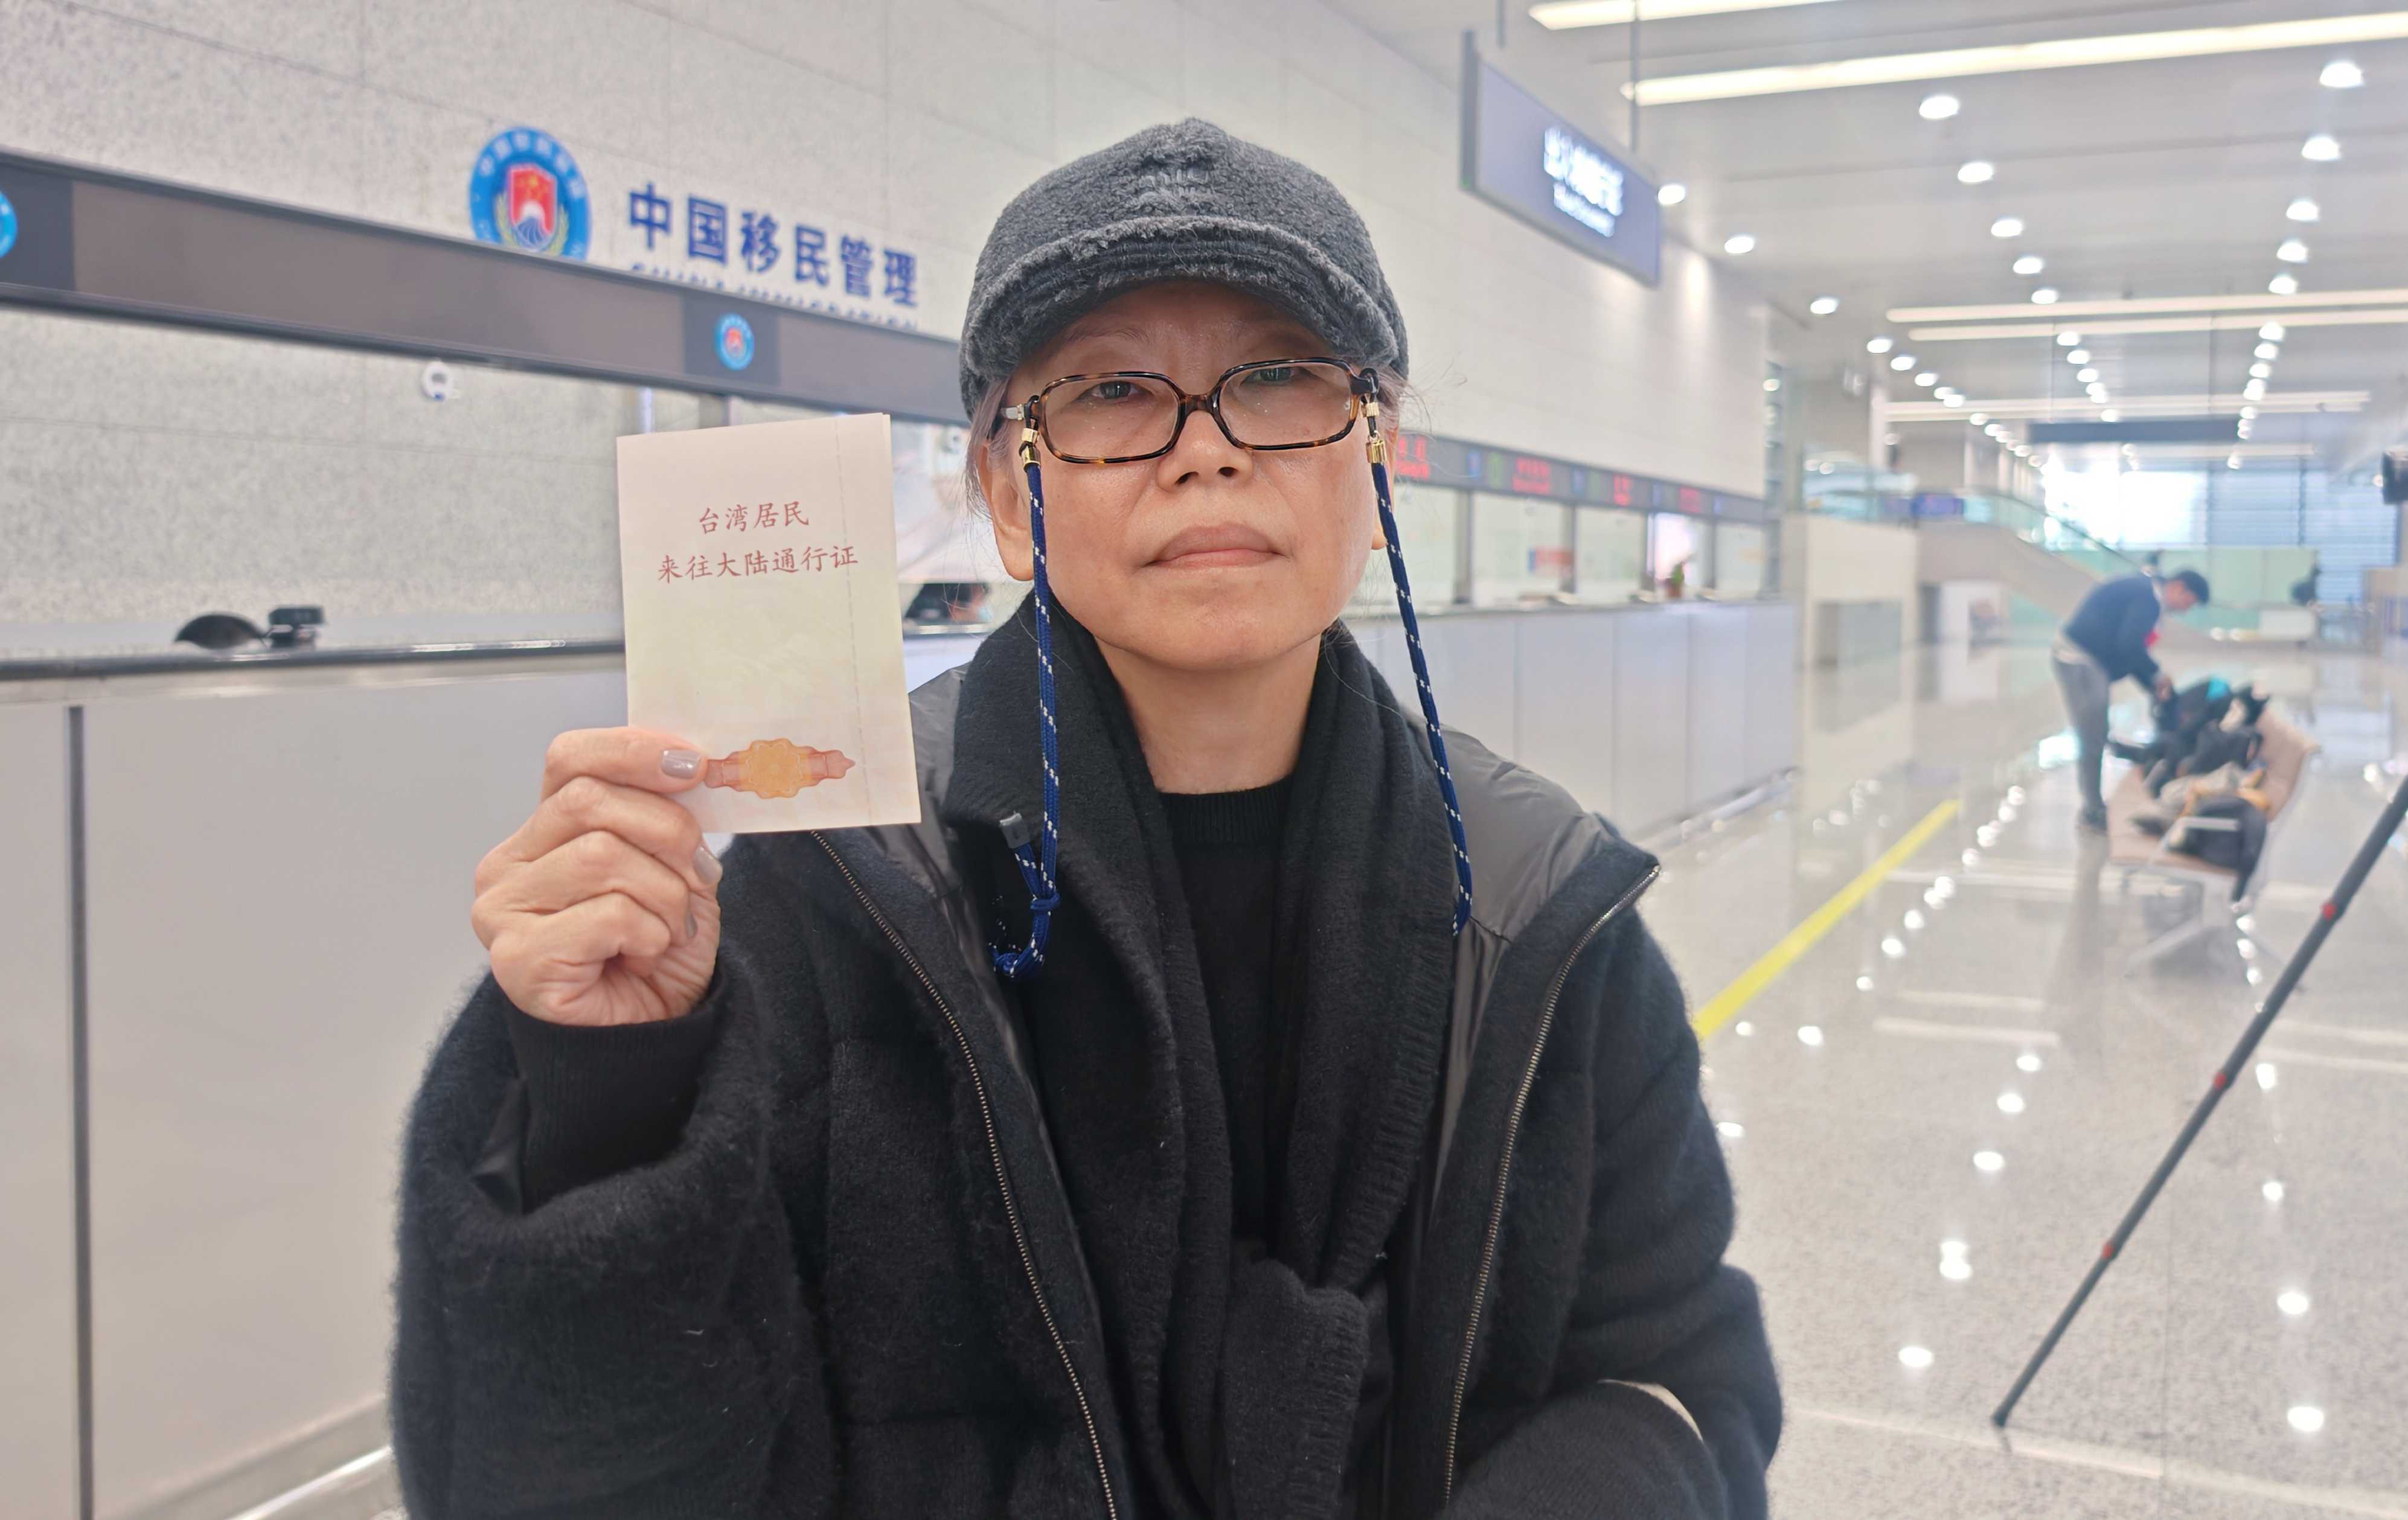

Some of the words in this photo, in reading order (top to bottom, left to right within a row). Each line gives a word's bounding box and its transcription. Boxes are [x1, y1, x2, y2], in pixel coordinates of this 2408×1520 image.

[629, 183, 918, 307] 中国移民管理
[698, 501, 810, 534] 台湾居民
[658, 545, 859, 584] 来往大陆通行证
